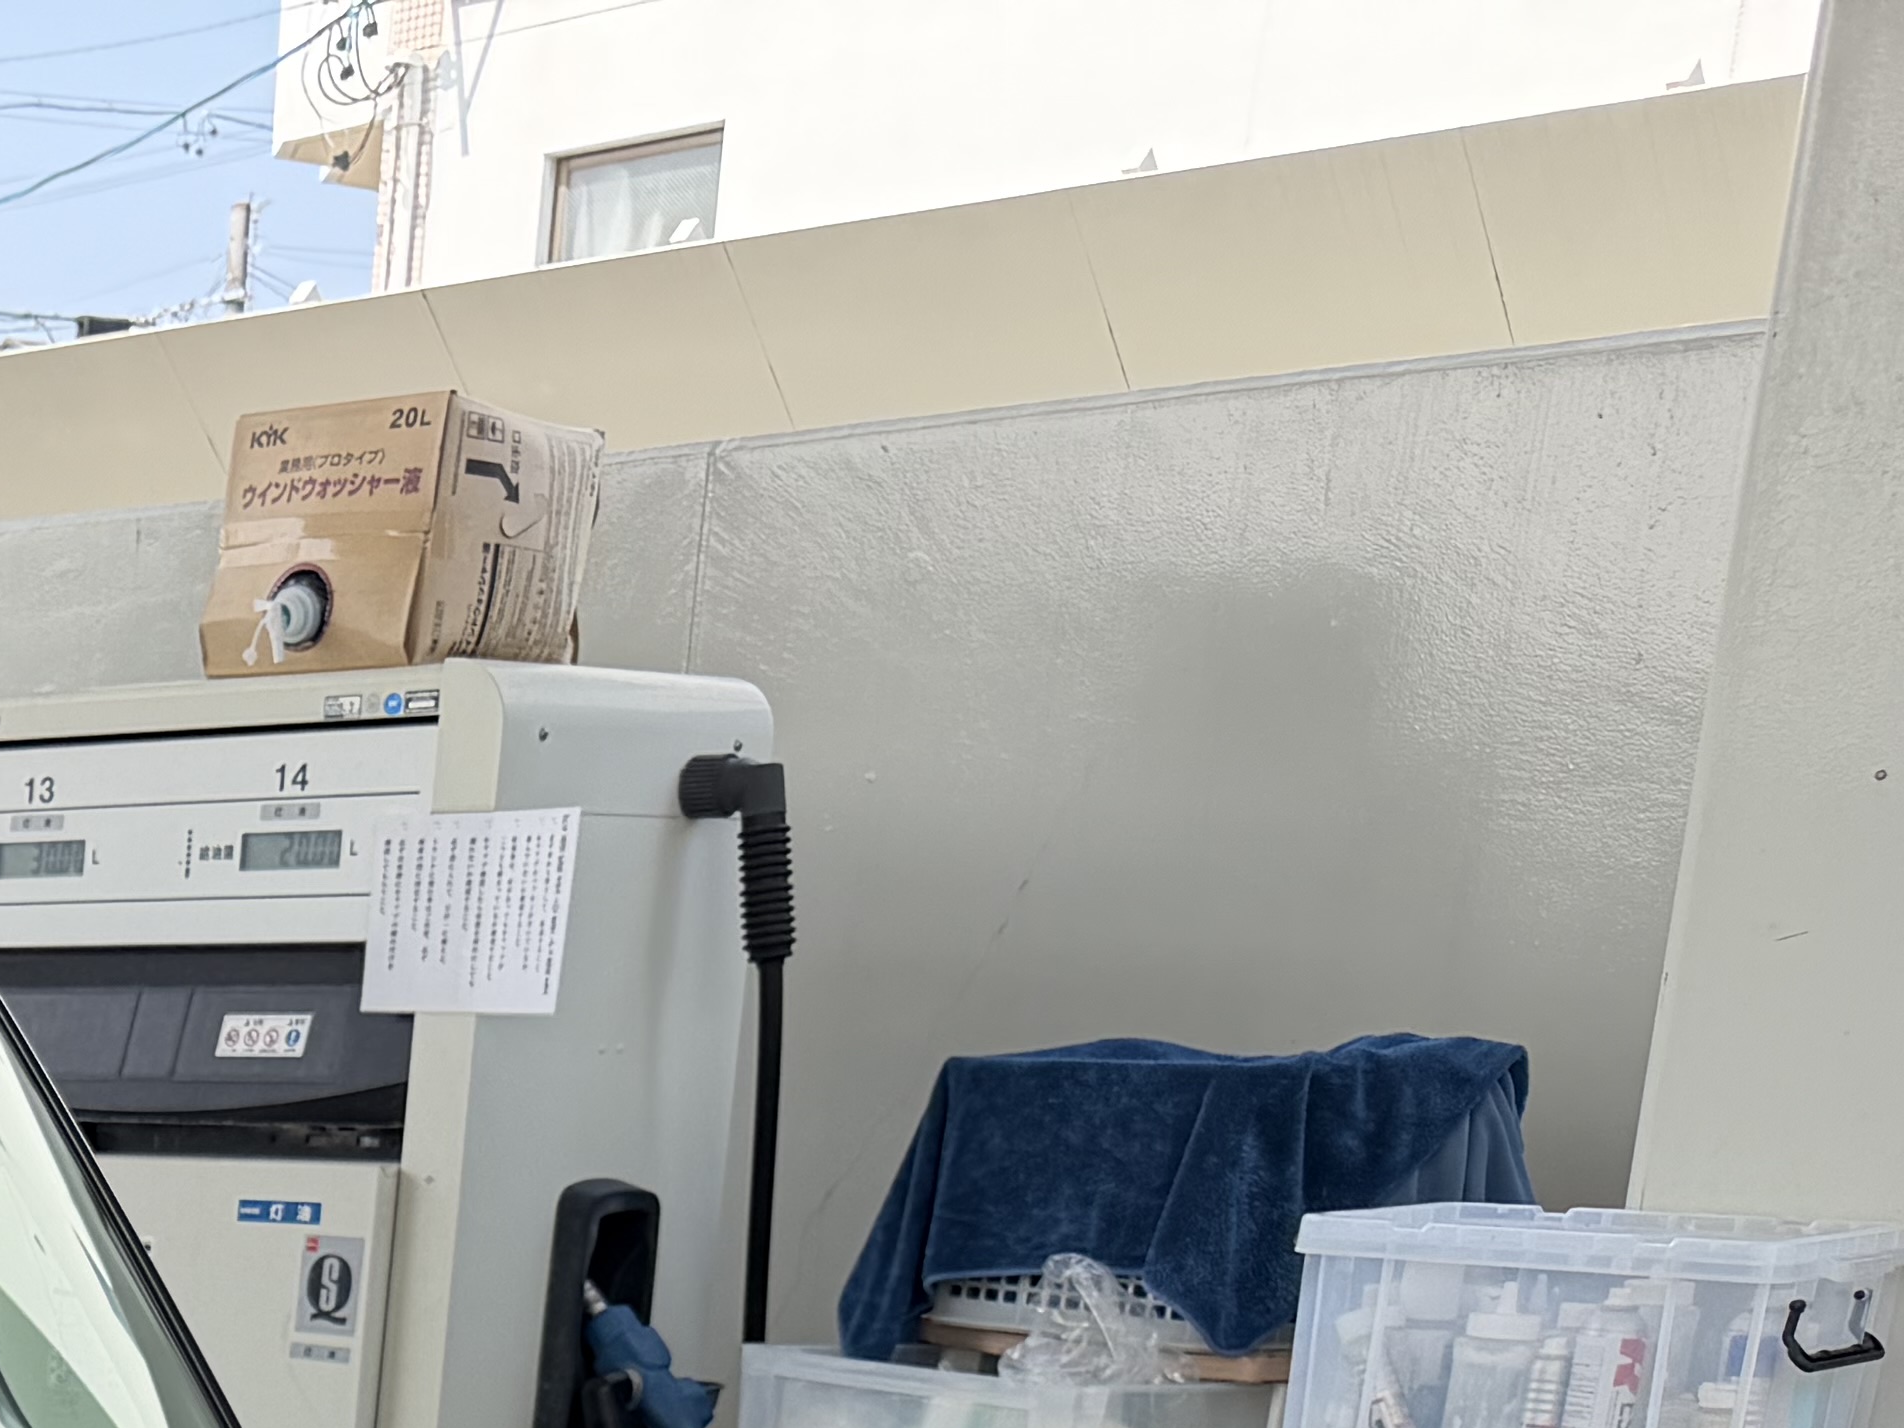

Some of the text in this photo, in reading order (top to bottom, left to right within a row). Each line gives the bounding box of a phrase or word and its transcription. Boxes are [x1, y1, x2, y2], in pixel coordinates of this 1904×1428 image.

[389, 407, 432, 429] 20L
[242, 467, 423, 510] ウインドウォッシャー液
[24, 776, 55, 804] 13
[276, 763, 308, 792] 14
[350, 839, 358, 856] L
